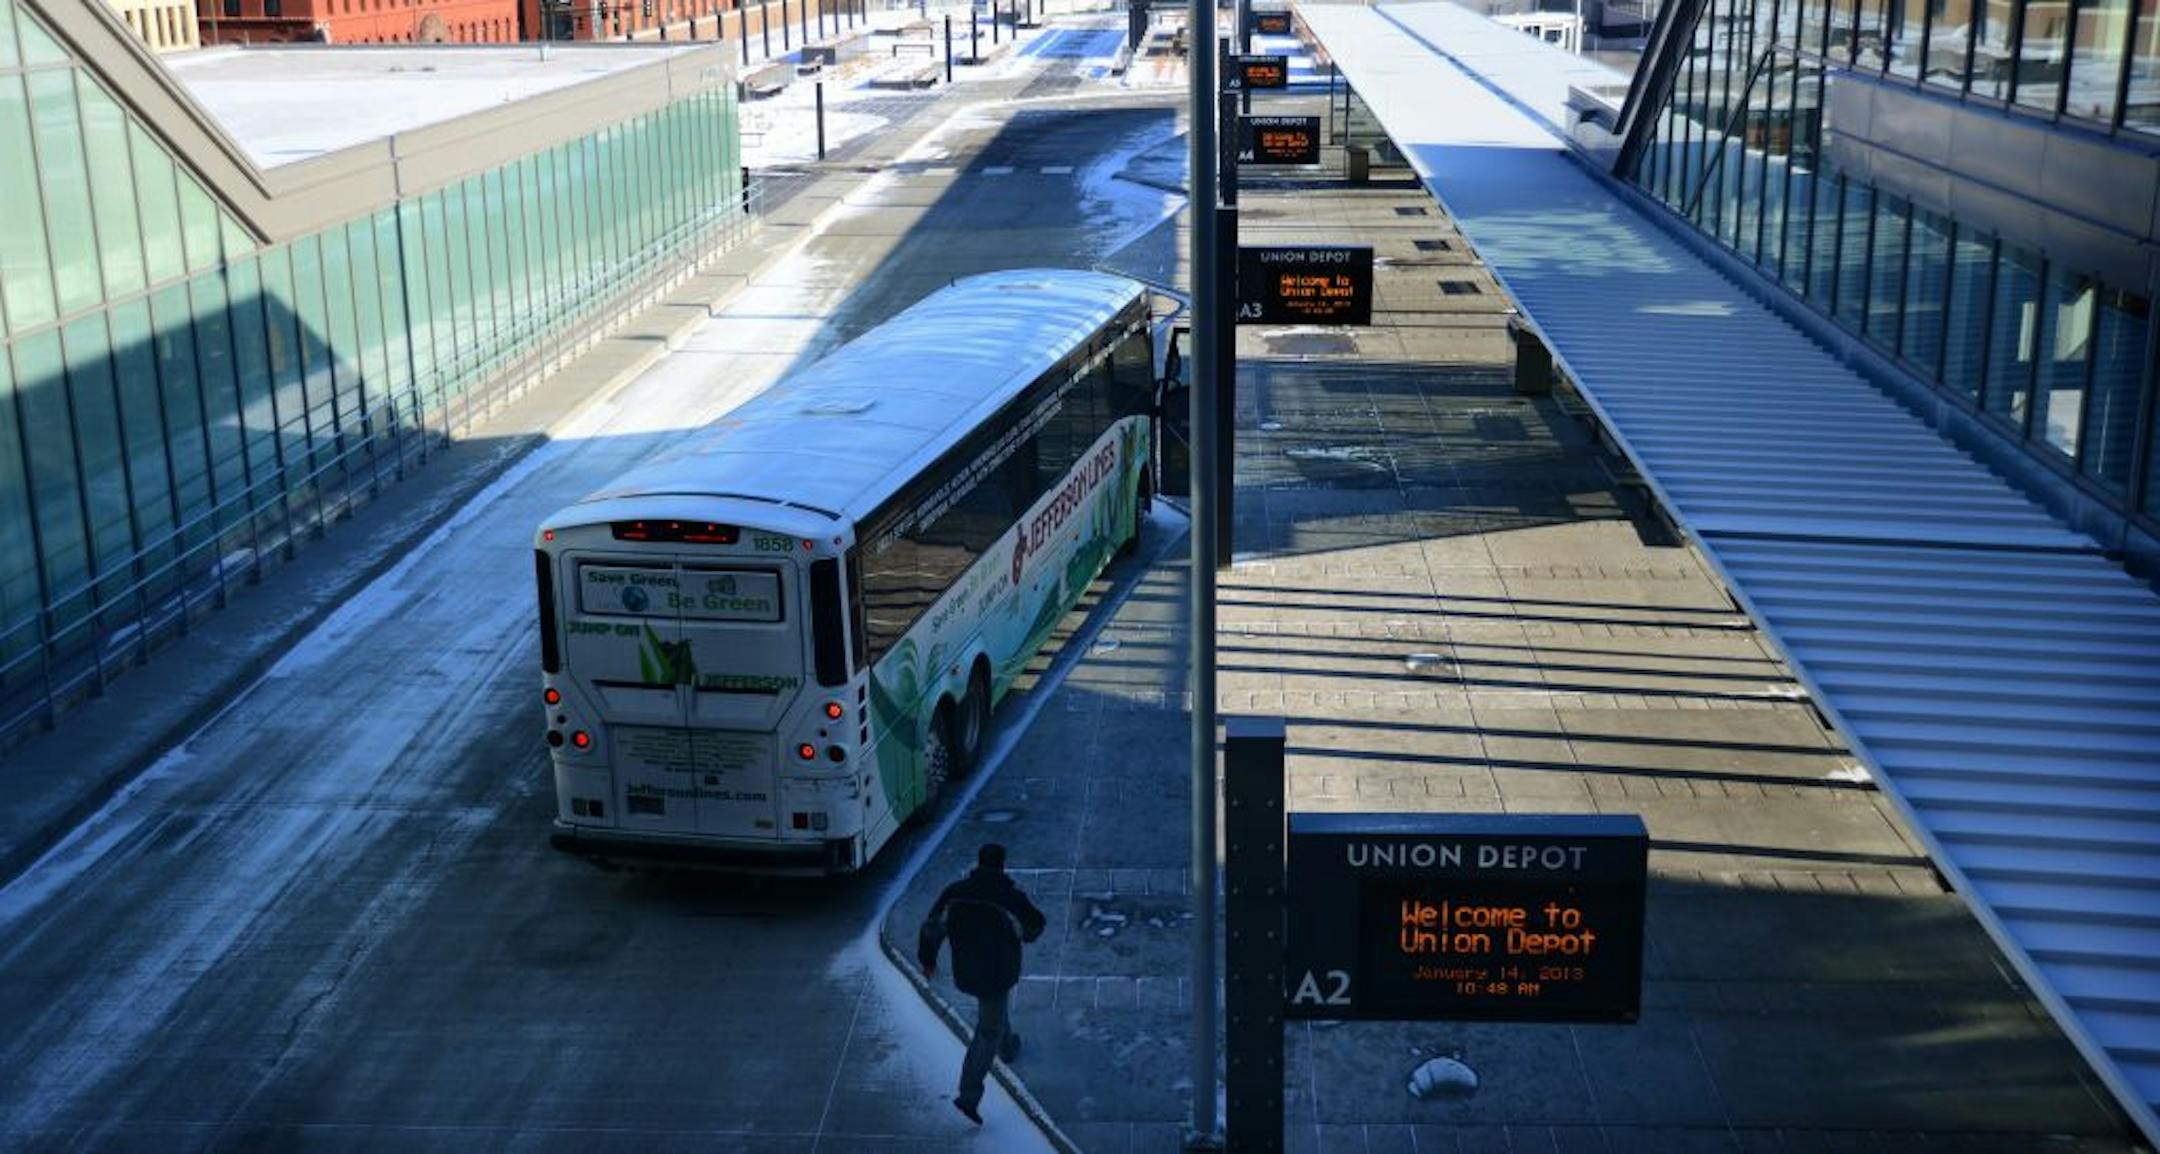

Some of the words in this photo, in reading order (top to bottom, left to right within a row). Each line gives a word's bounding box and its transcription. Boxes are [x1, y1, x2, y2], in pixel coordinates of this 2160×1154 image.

[1260, 251, 1305, 263] UNION
[1309, 251, 1351, 263] DEPOT
[1281, 273, 1330, 287] Welcome
[1336, 273, 1350, 286] to
[1280, 286, 1316, 297] Union
[1320, 286, 1353, 298] Depot
[1240, 302, 1263, 318] A3
[1028, 466, 1088, 557] JEFFERSON
[1089, 440, 1115, 490] LINES
[588, 571, 627, 585] Save
[668, 592, 697, 610] Be
[703, 594, 770, 613] Green
[568, 622, 612, 635] JUMP
[615, 624, 641, 637] ON
[702, 673, 799, 689] JEFFERSON
[1347, 843, 1462, 869] UNION
[1477, 845, 1588, 870] DEPOT
[1401, 900, 1527, 928] Welcome
[1544, 901, 1582, 929] to
[1401, 928, 1491, 954] Union
[1506, 928, 1597, 955] Depot
[1413, 965, 1487, 981] January
[1539, 966, 1585, 981] 2013
[1292, 969, 1351, 1005] A2
[1518, 982, 1541, 997] AM
